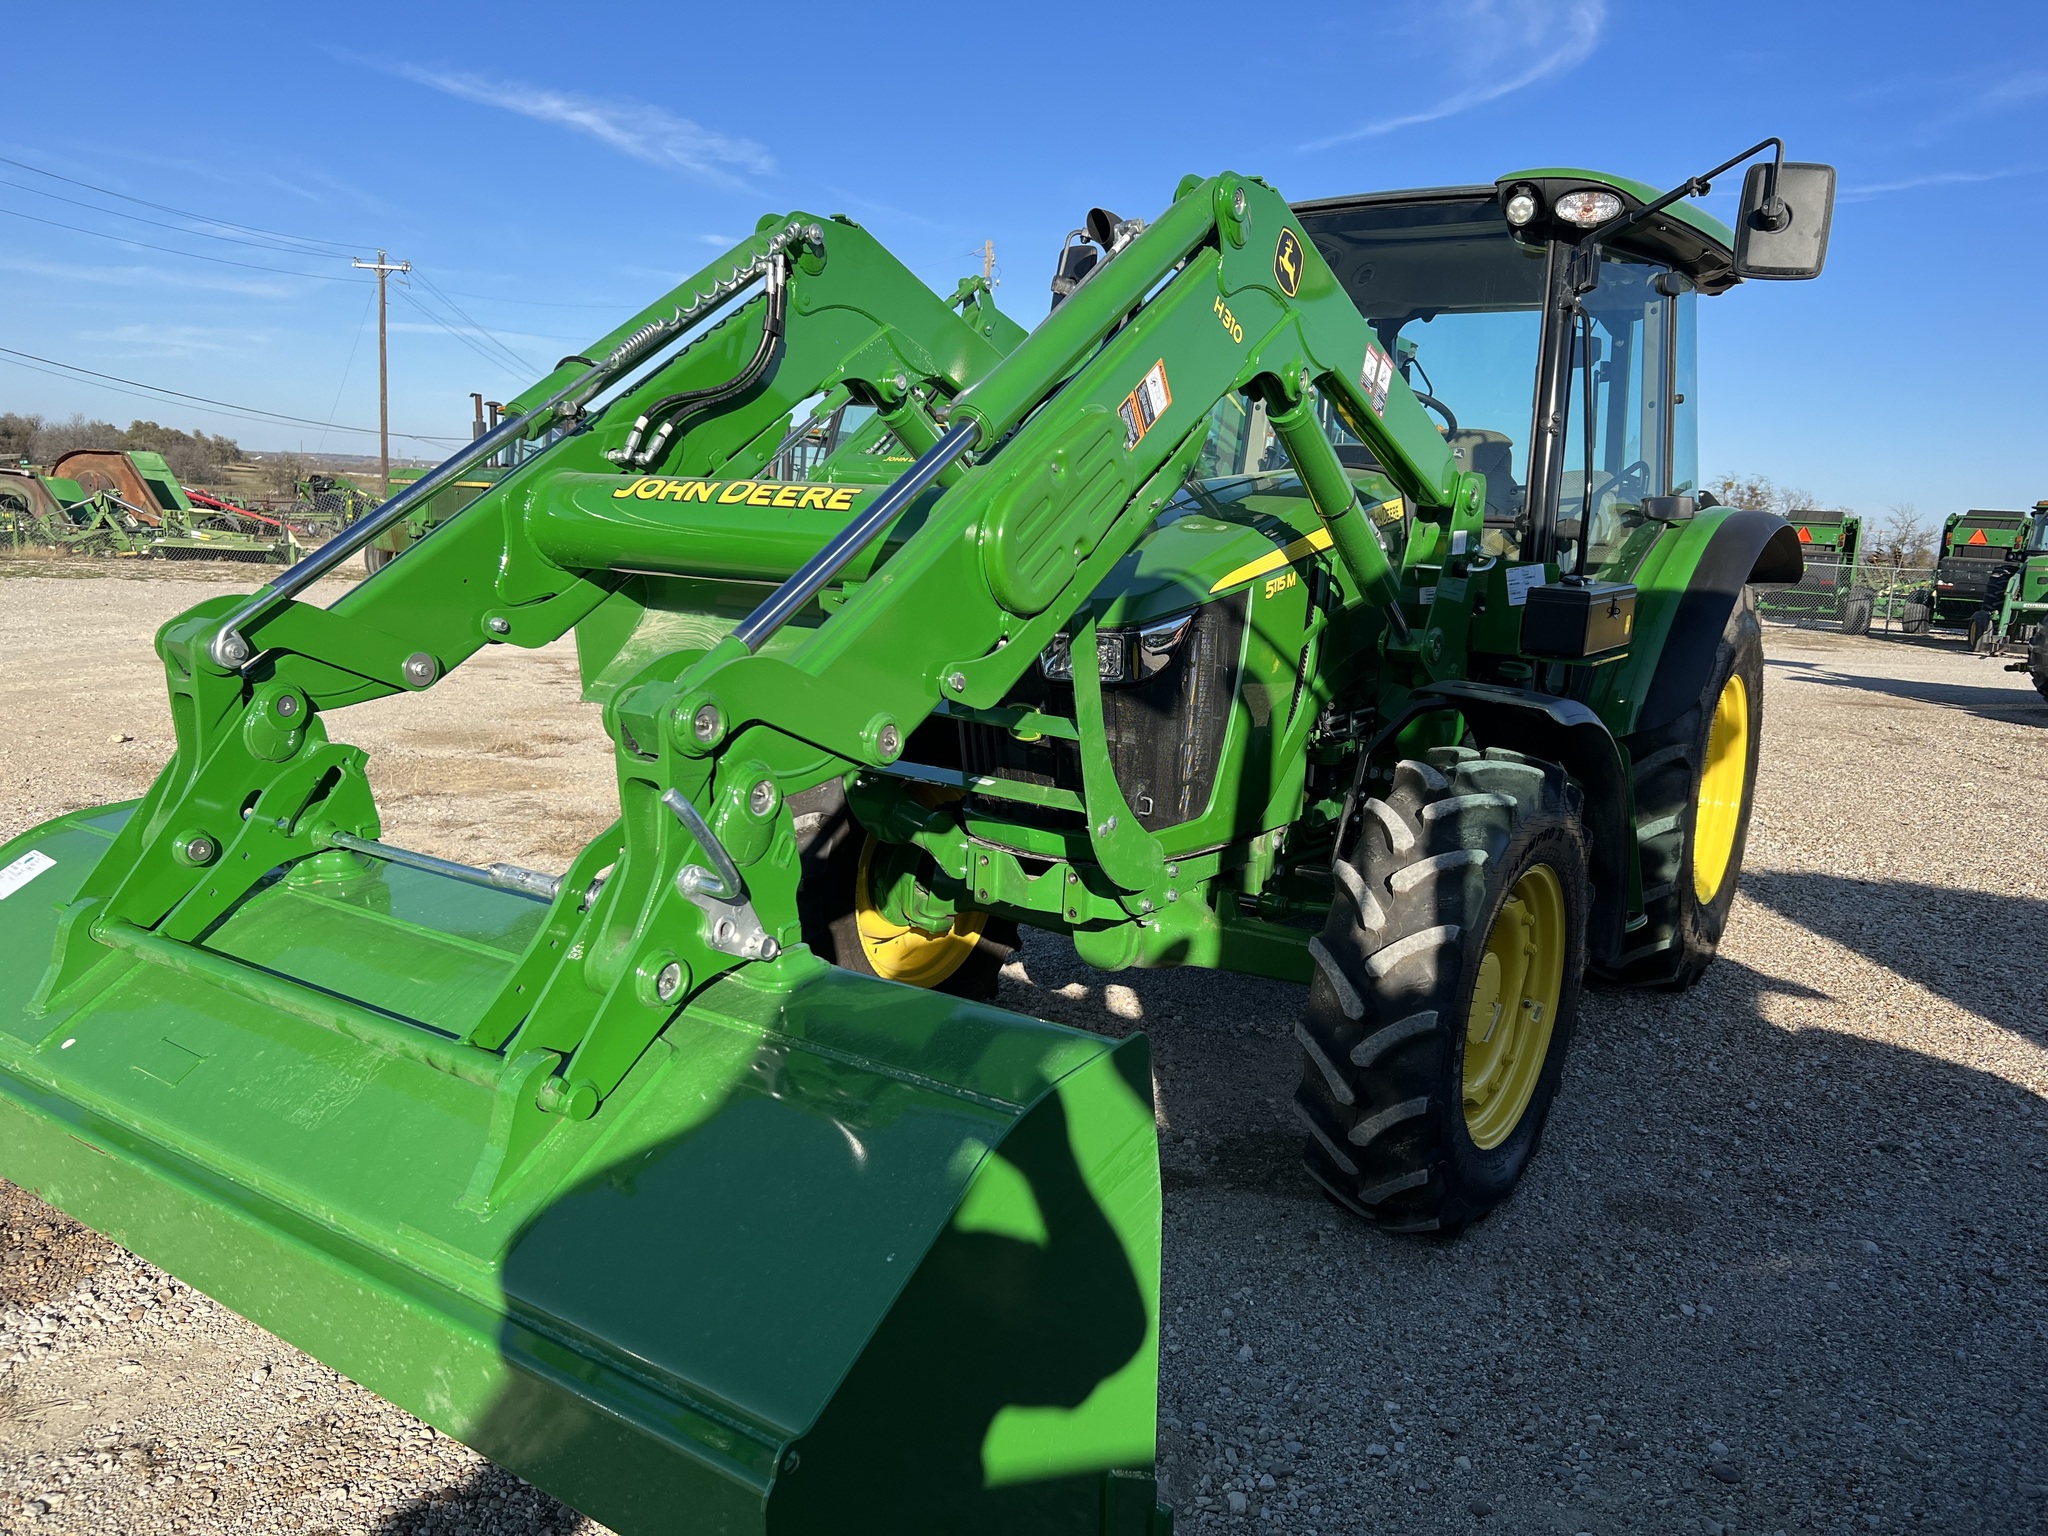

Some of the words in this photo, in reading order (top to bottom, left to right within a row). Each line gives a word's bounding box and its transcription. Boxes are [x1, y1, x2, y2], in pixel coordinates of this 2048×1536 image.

[1213, 294, 1243, 344] H310
[612, 478, 721, 503] JOHN
[716, 481, 863, 511] DEERE
